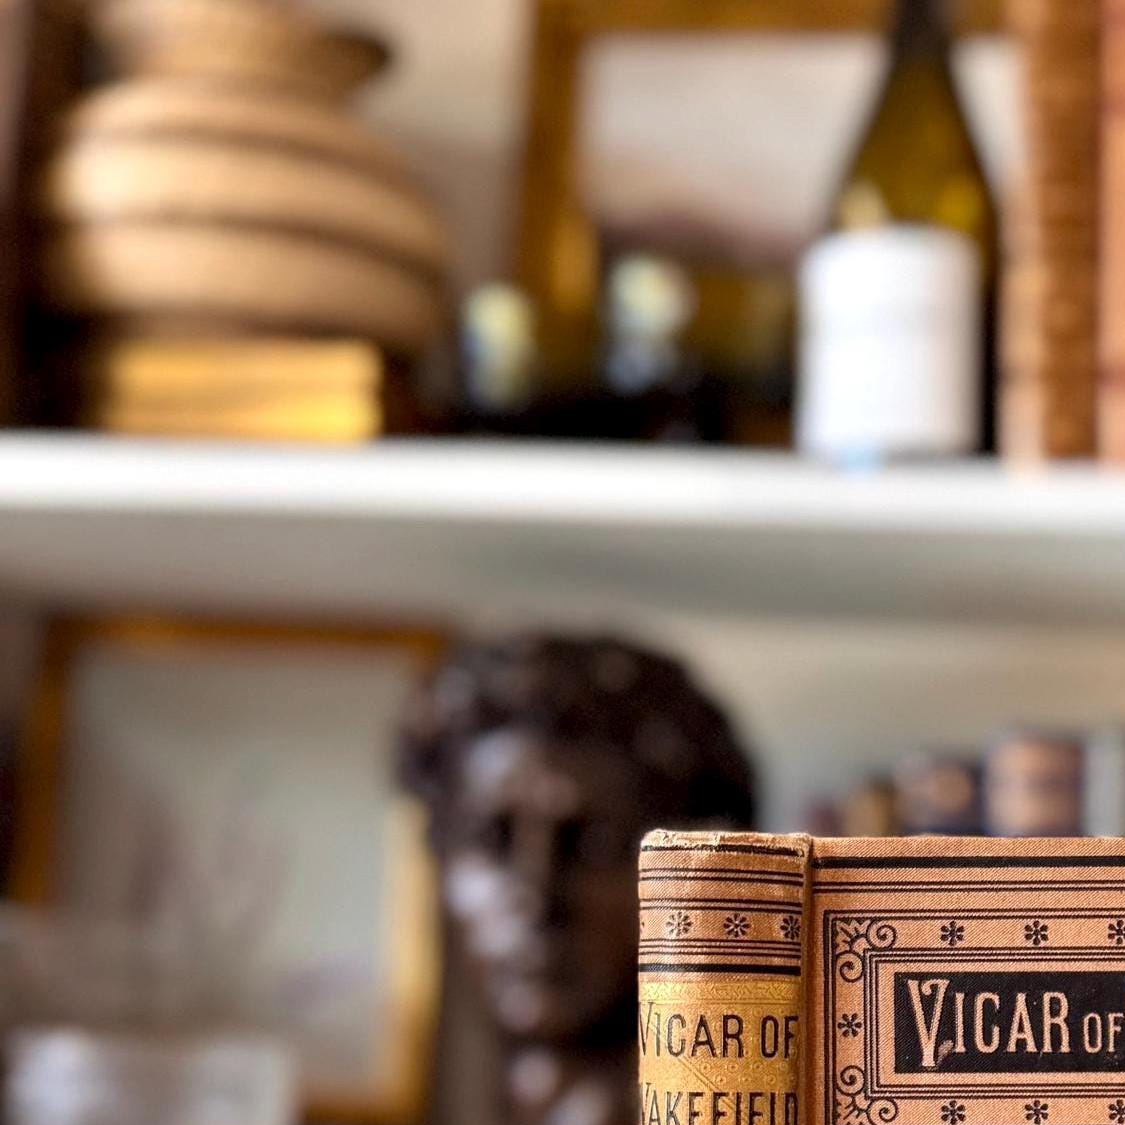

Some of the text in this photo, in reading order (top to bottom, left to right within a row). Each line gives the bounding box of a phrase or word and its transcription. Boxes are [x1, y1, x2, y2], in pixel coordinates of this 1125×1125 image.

[761, 1015, 799, 1058] OF
[907, 978, 1070, 1068] VICAR
[1082, 1012, 1125, 1053] OF
